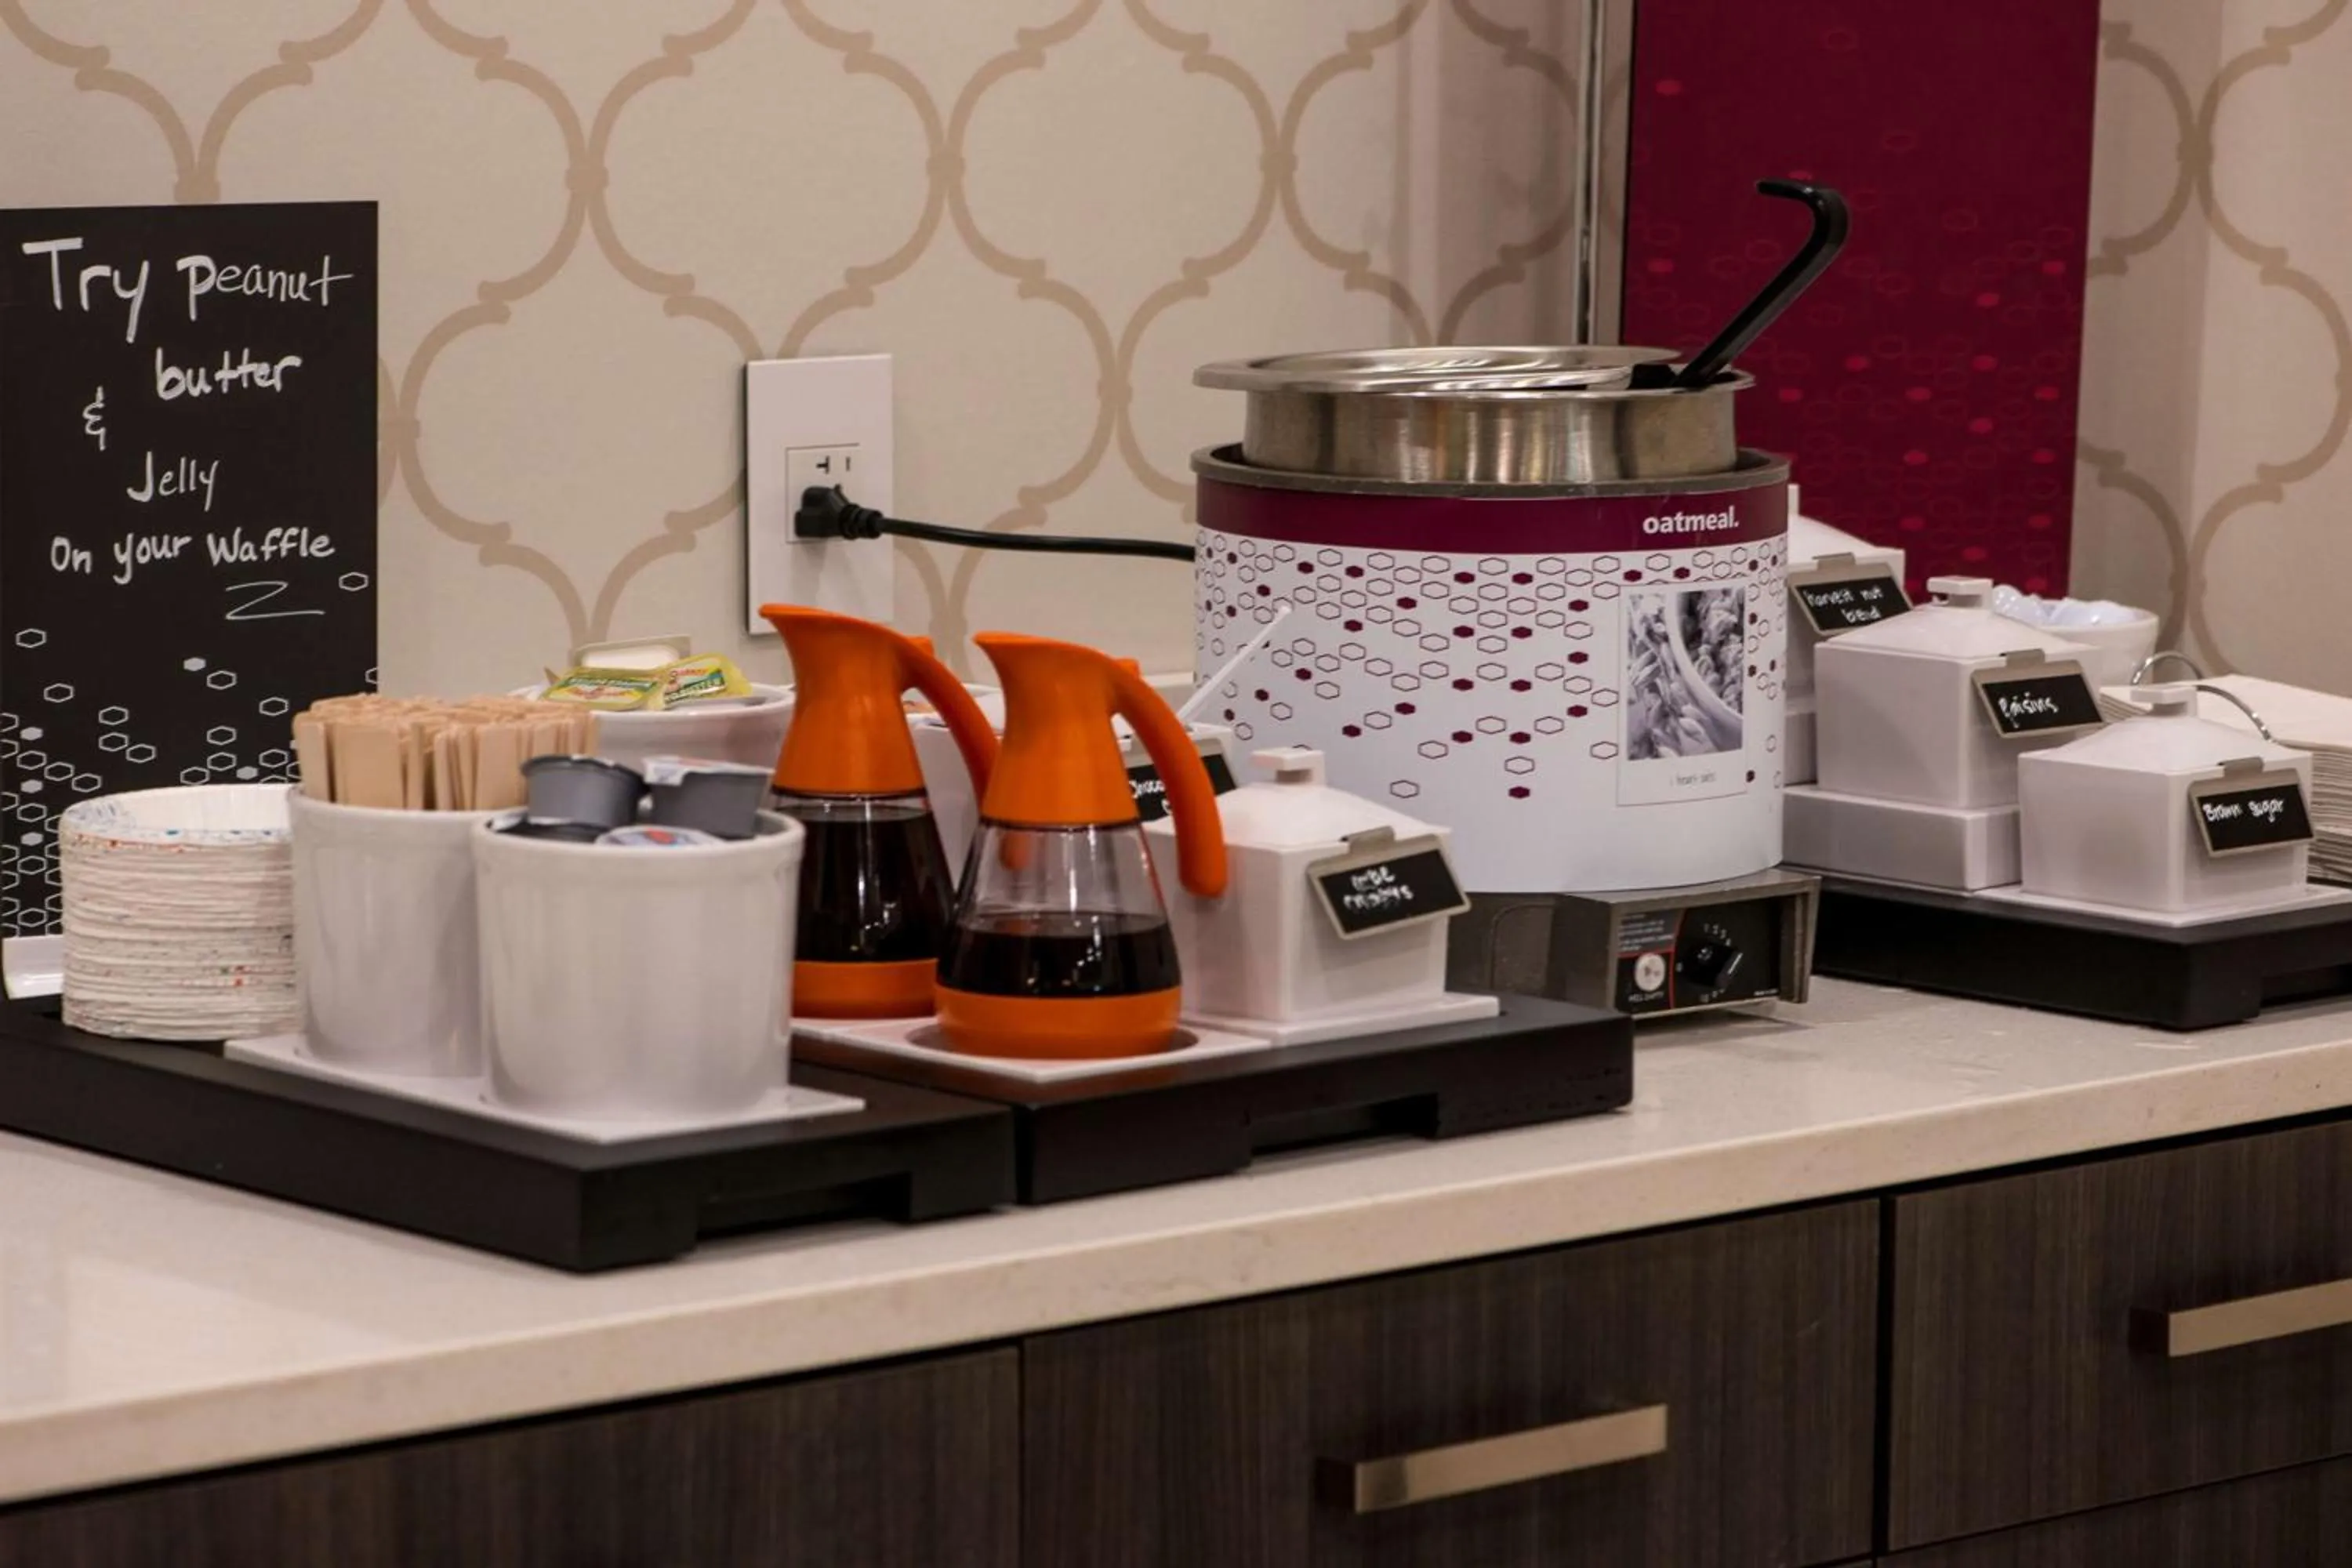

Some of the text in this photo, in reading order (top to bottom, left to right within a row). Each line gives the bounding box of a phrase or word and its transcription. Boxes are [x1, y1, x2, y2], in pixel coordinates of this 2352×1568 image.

[21, 236, 151, 344] Try
[154, 347, 303, 401] butter
[82, 385, 107, 452] &
[126, 451, 220, 512] Jelly
[1642, 504, 1740, 534] oatmeal.
[50, 526, 336, 586] On your Waffle
